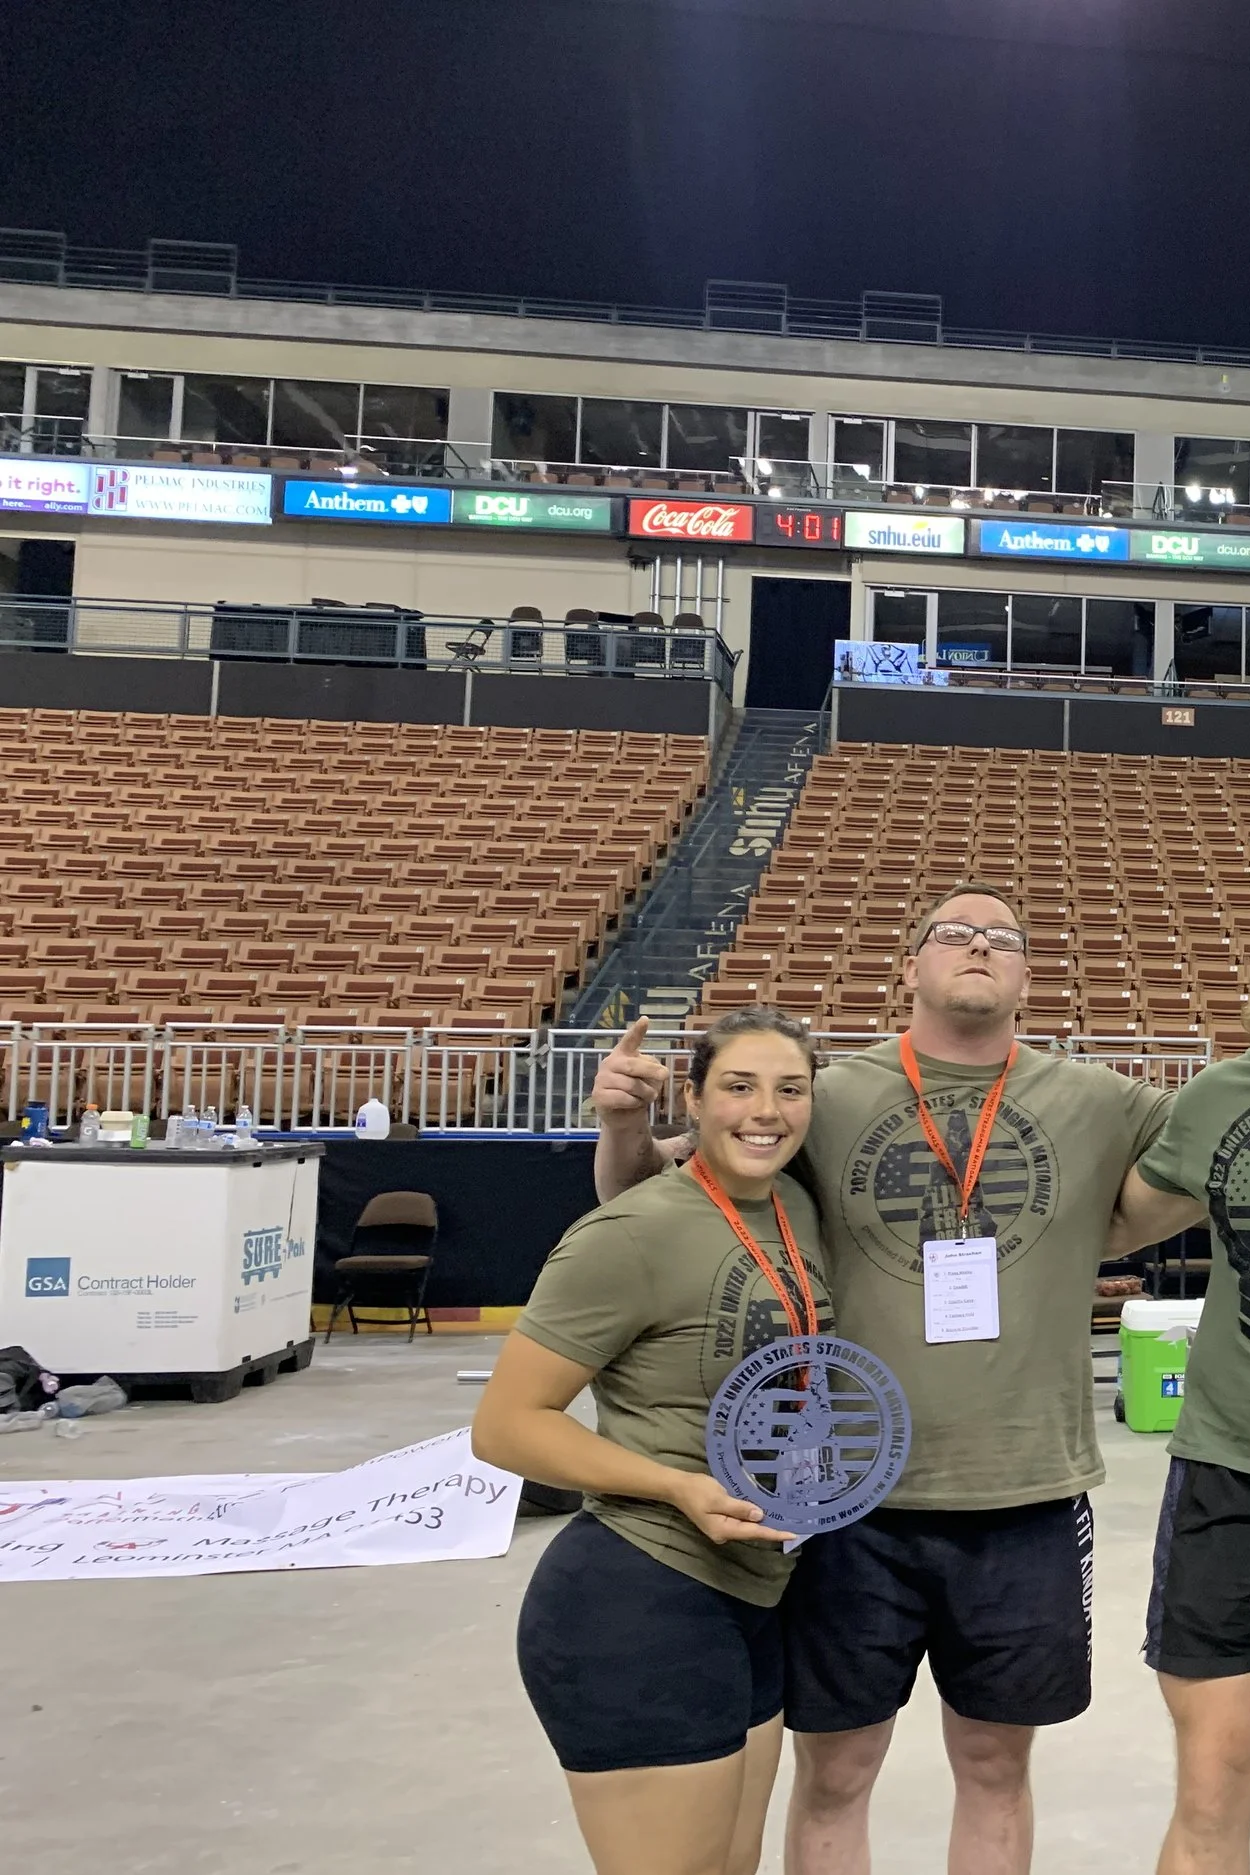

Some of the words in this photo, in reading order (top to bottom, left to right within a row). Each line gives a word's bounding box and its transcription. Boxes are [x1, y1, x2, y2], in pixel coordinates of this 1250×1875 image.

[8, 475, 22, 490] it
[28, 477, 81, 496] right.
[191, 477, 267, 491] INDUSTRIES
[43, 501, 84, 512] ally.com
[304, 489, 388, 513] Anthem
[475, 494, 530, 516] DCU
[547, 504, 593, 520] dcu.org
[641, 503, 740, 537] Coca-Cola
[776, 513, 839, 541] 4:01
[868, 525, 942, 549] snhu.edu
[998, 529, 1074, 551] Anthem
[1151, 534, 1201, 555] DCU
[1165, 710, 1192, 724] 121
[859, 1113, 905, 1157] UNITED
[969, 1095, 1040, 1146] STONGMAN
[850, 1159, 872, 1196] 2022
[1029, 1145, 1052, 1216] NATIONALS
[861, 1224, 899, 1260] Presented
[28, 1276, 67, 1292] GSA
[77, 1275, 144, 1291] Contract
[146, 1274, 197, 1289] Holder
[720, 1265, 748, 1314] UNITED
[714, 1318, 737, 1359] 2022
[713, 1402, 733, 1437] 2022
[723, 1359, 763, 1401] UNITED
[762, 1341, 811, 1365] STATES
[816, 1341, 890, 1388] STRONGMAN
[883, 1388, 906, 1460] NATIONALS
[368, 1473, 508, 1512] Therapy
[192, 1509, 356, 1547] Massage
[1076, 1508, 1093, 1547] FIT
[72, 1548, 264, 1565] Leominster
[278, 1532, 331, 1551] MA
